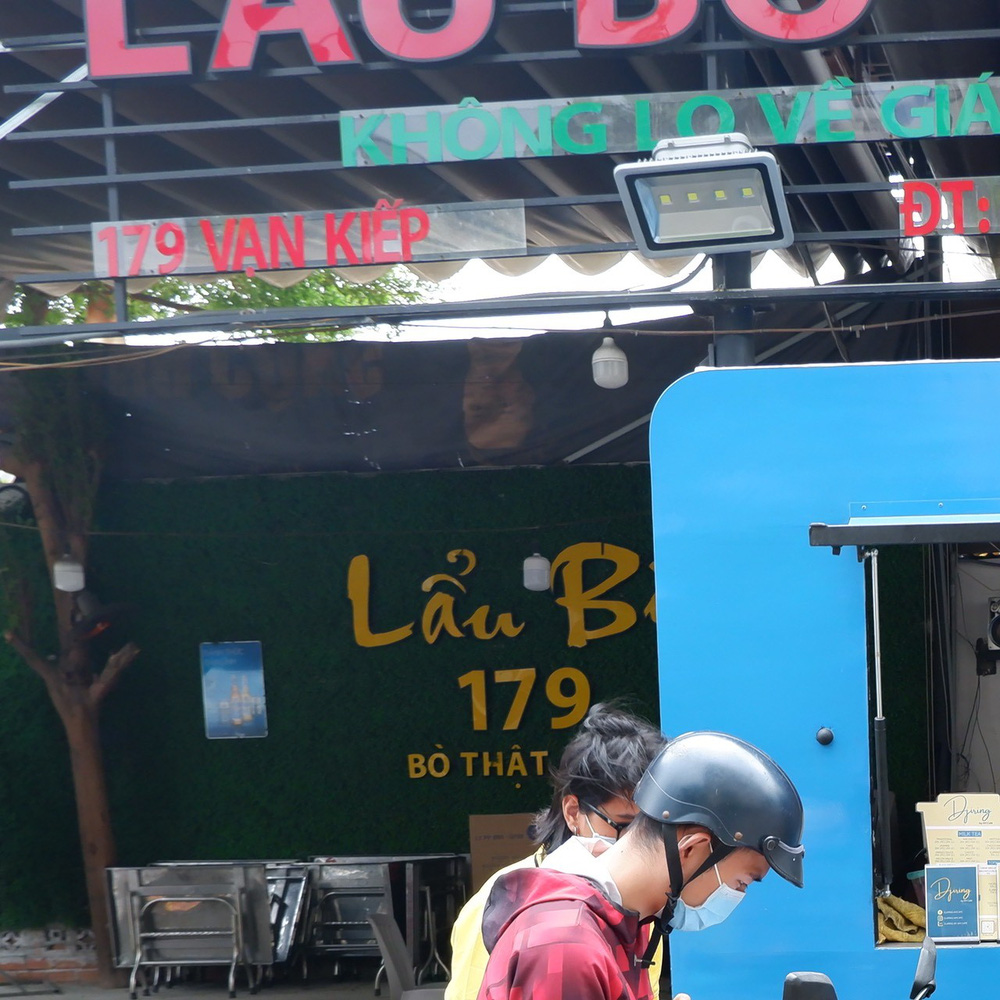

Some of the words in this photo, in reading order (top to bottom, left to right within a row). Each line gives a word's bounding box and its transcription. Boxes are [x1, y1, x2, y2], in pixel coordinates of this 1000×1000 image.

[340, 97, 608, 166] KHÔNG
[99, 222, 186, 278] 179
[200, 212, 306, 278] VẠN
[325, 198, 431, 268] KIẾP
[347, 549, 525, 648] Lẩu
[549, 541, 657, 648] B
[457, 666, 592, 731] 179
[408, 744, 450, 779] BÒ
[460, 743, 549, 789] THẬT
